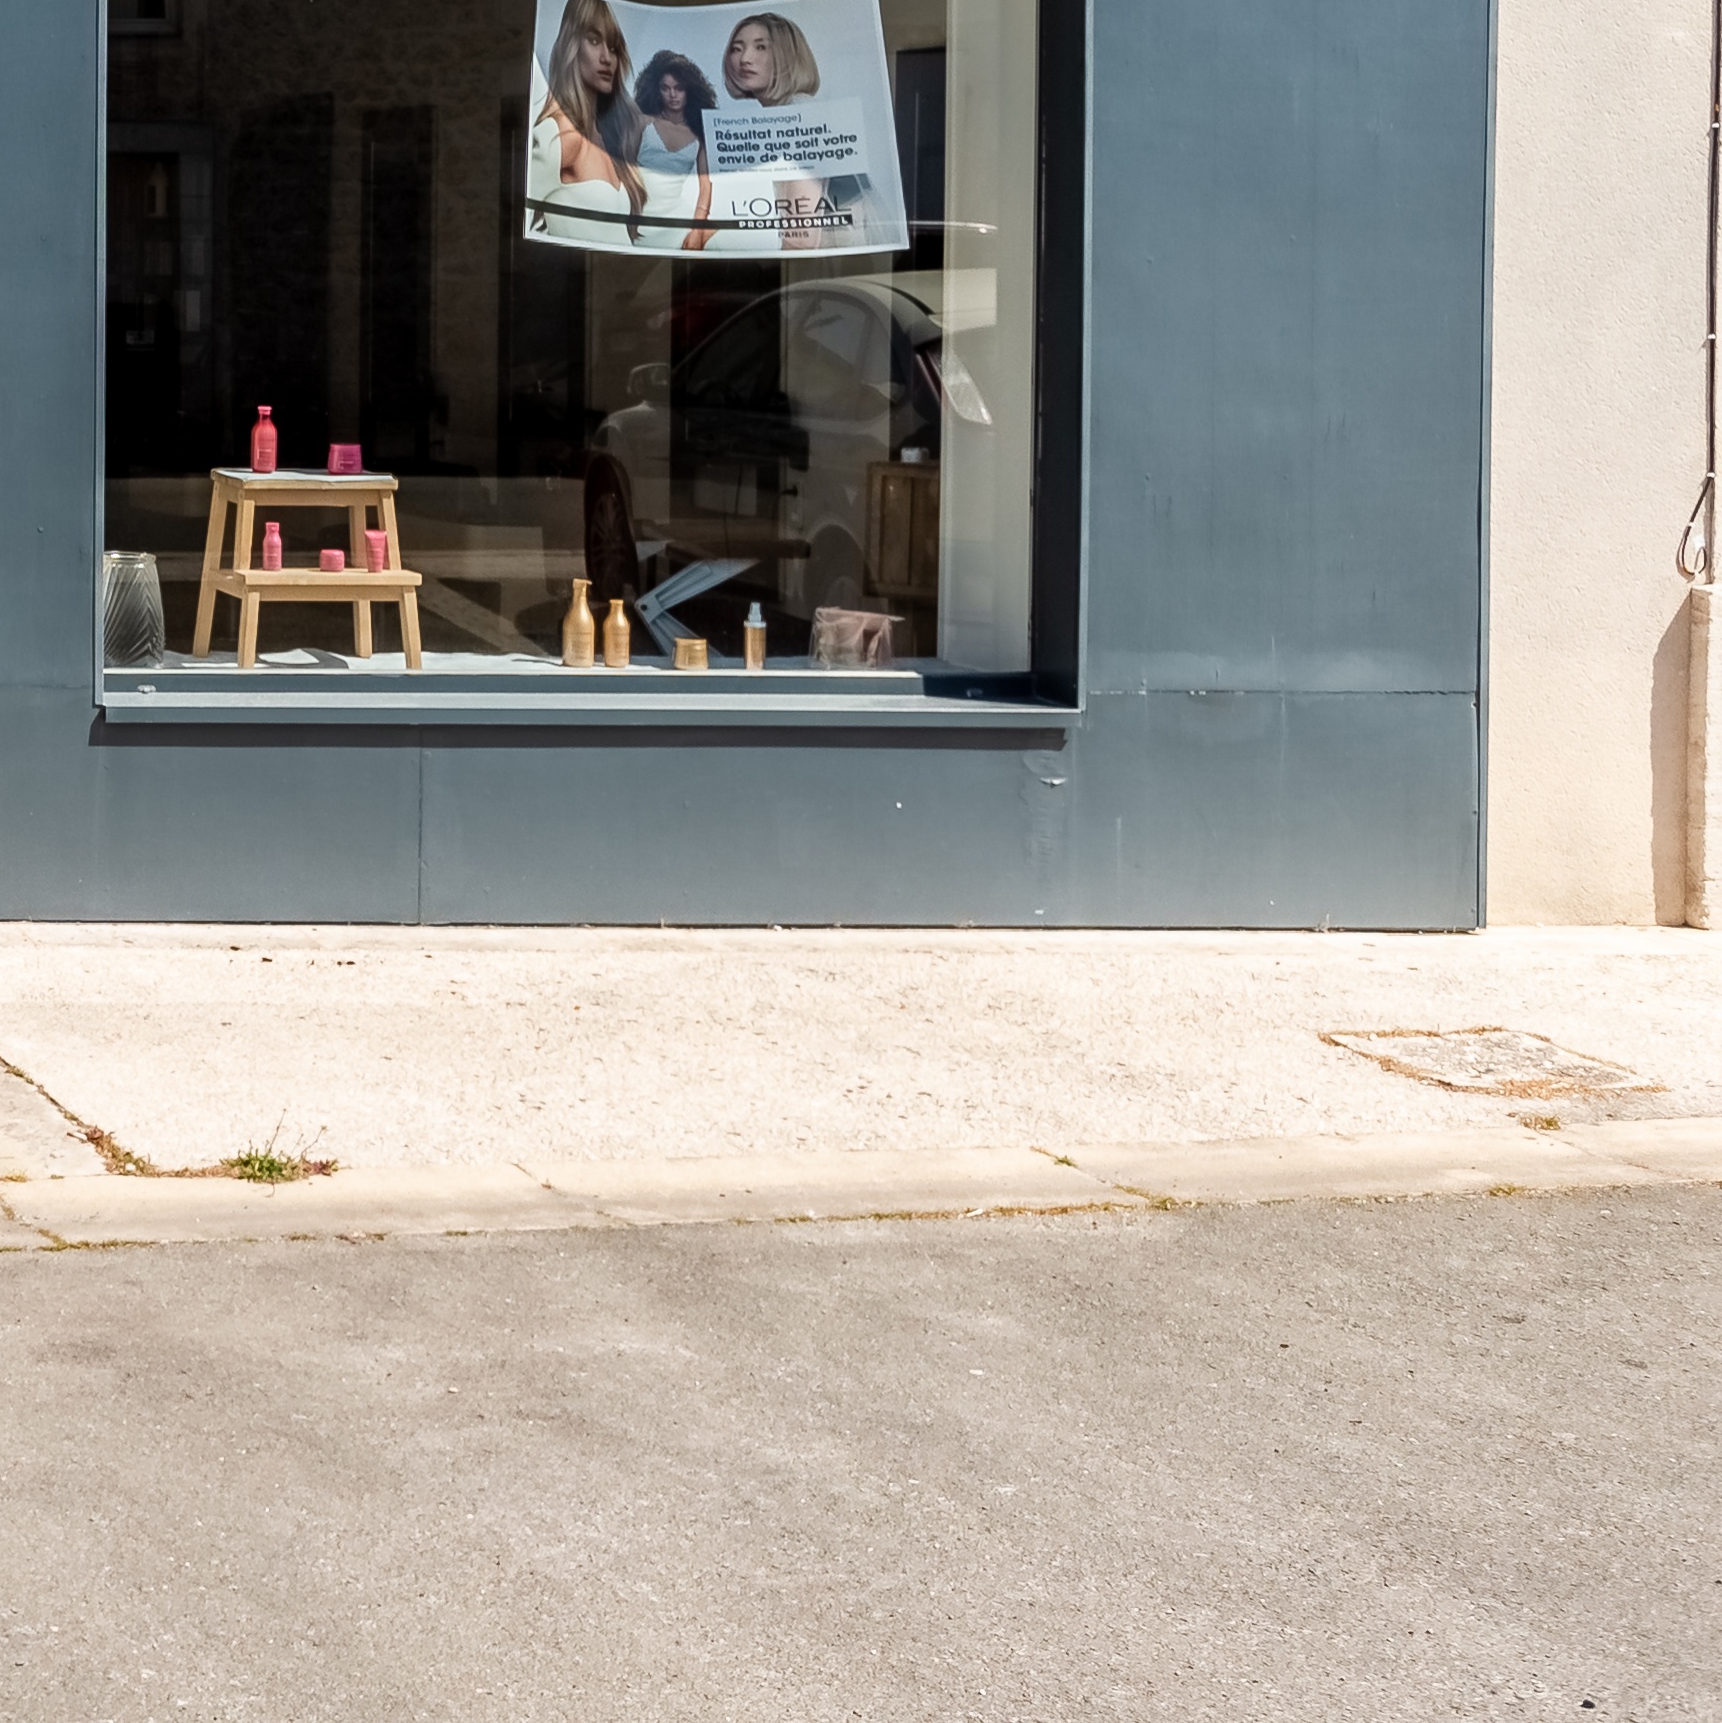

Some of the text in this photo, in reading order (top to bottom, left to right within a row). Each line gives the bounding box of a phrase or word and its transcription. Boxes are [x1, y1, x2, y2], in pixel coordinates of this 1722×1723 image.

[715, 123, 832, 141] Résultat naturel.
[716, 133, 858, 153] Quelle que soit votre
[717, 146, 858, 165] envie de balayage.
[738, 216, 849, 229] PROFESSIONNEL
[777, 230, 810, 239] PARIS
